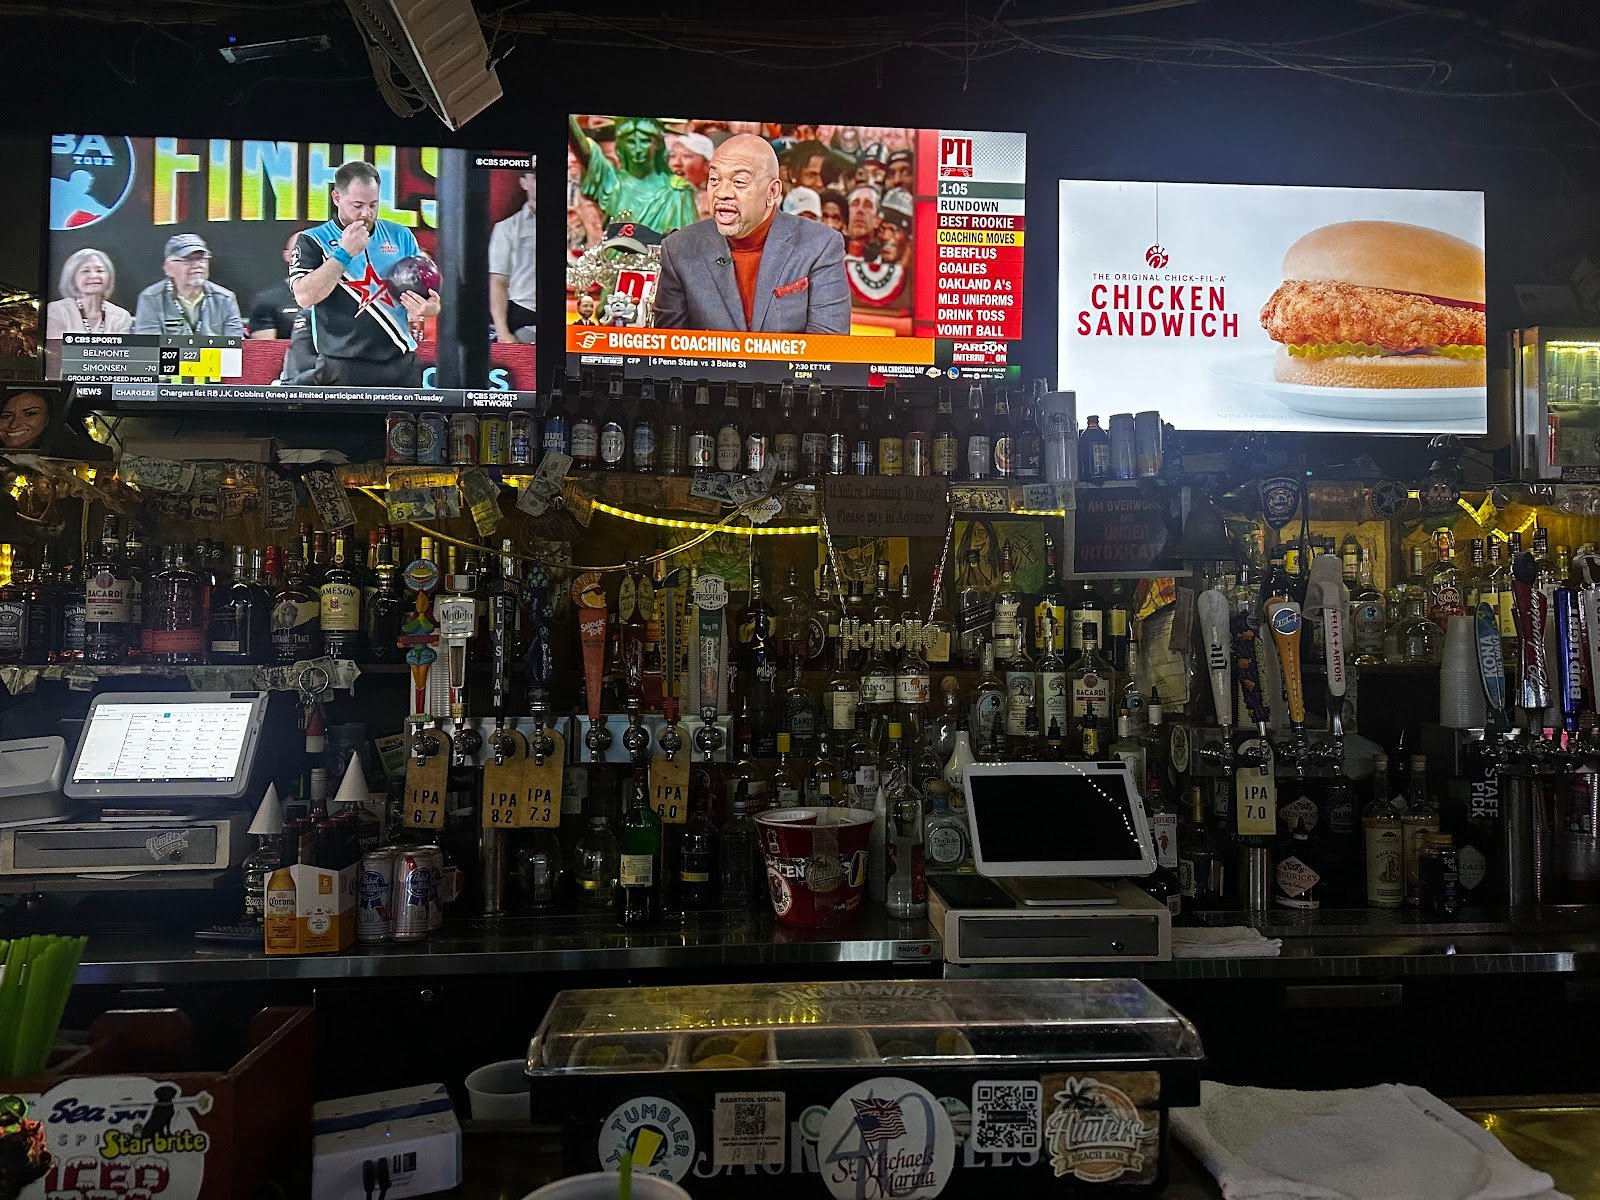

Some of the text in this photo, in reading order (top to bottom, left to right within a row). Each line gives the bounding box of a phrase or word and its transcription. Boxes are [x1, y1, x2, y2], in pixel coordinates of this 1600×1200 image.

[941, 138, 972, 166] PTI
[482, 158, 530, 168] CBS SPORTS
[940, 183, 968, 195] 1:05
[940, 200, 999, 213] RUNDOWN
[940, 216, 1014, 229] BEST ROOKIE
[939, 231, 1015, 245] COACHING MOVES
[939, 246, 997, 260] EBERFLUS
[938, 262, 987, 275] GOALIES
[938, 277, 1012, 291] OAKLAND A's
[1092, 273, 1110, 281] THE
[1114, 273, 1160, 281] ORIGINAL
[938, 293, 1014, 306] MLB UNIFORMS
[1091, 284, 1225, 311] CHICKEN
[937, 309, 1006, 321] DRINK TOSS
[937, 324, 1004, 337] VOMIT BALL
[1077, 311, 1239, 338] SANDWICH
[74, 336, 123, 345] CBS SPORTS
[608, 332, 807, 356] BIGGEST COACHING CHANGE?
[953, 341, 1007, 352] PARDON
[83, 349, 130, 358] BELMONTE
[161, 351, 198, 360] 207 227
[82, 363, 127, 372] SIMONSEN
[627, 357, 641, 365] CFP
[652, 358, 658, 366] 6
[658, 358, 677, 366] Penn
[678, 359, 698, 367] State
[710, 360, 716, 368] 3
[716, 360, 736, 368] Boise
[738, 360, 747, 369] St
[795, 363, 809, 371] 7:30
[163, 364, 176, 373] 127
[794, 371, 812, 379] ESPN
[915, 366, 925, 375] DAY
[67, 375, 91, 383] GROUP
[76, 388, 102, 396] NEWS
[160, 389, 194, 398] Chargers
[194, 389, 206, 397] list
[265, 391, 289, 399] (knee)
[298, 391, 323, 399] limited
[324, 392, 364, 402] participant
[373, 393, 402, 402] practice
[414, 393, 444, 403] Tuesday
[473, 393, 518, 401] CBS SPORTS
[473, 400, 513, 408] NETWORK
[544, 431, 562, 441] BUD
[865, 484, 901, 504] Drinking
[903, 485, 914, 500] To
[1087, 500, 1104, 512] AM
[837, 509, 935, 527] Please pay in Advance
[441, 608, 473, 623] Modelo
[580, 618, 606, 633] SHOCK
[586, 626, 603, 637] TOP
[659, 602, 669, 683] LANDSHARK
[673, 602, 684, 683] LANDSHARK
[1527, 587, 1549, 693] Budweiser
[492, 595, 503, 707] ELYSIAN
[1479, 634, 1496, 678] KONA
[1567, 608, 1582, 700] BUD LIGHT
[1332, 649, 1342, 683] ARTOIS
[413, 789, 439, 805] IPA
[490, 792, 517, 807] IPA
[527, 788, 552, 803] IPA
[656, 785, 682, 801] IPA
[1244, 786, 1269, 800] IPA
[1483, 766, 1499, 819] STAFF
[1471, 782, 1485, 819] PICK
[413, 809, 438, 824] 6.7
[490, 809, 513, 823] 8.2
[529, 807, 552, 822] 7.3
[657, 804, 678, 818] 6.0
[1245, 805, 1266, 819] 7.0
[322, 877, 328, 887] 6
[268, 898, 296, 907] Corona
[898, 945, 920, 954] FAGOR
[48, 1097, 106, 1124] Sea
[611, 1103, 690, 1157] TUMBLER
[1046, 1109, 1158, 1150] Hunters
[99, 1127, 208, 1160] Starbrite
[1071, 1152, 1124, 1161] BEACH BAR
[44, 1155, 170, 1194] ICED
